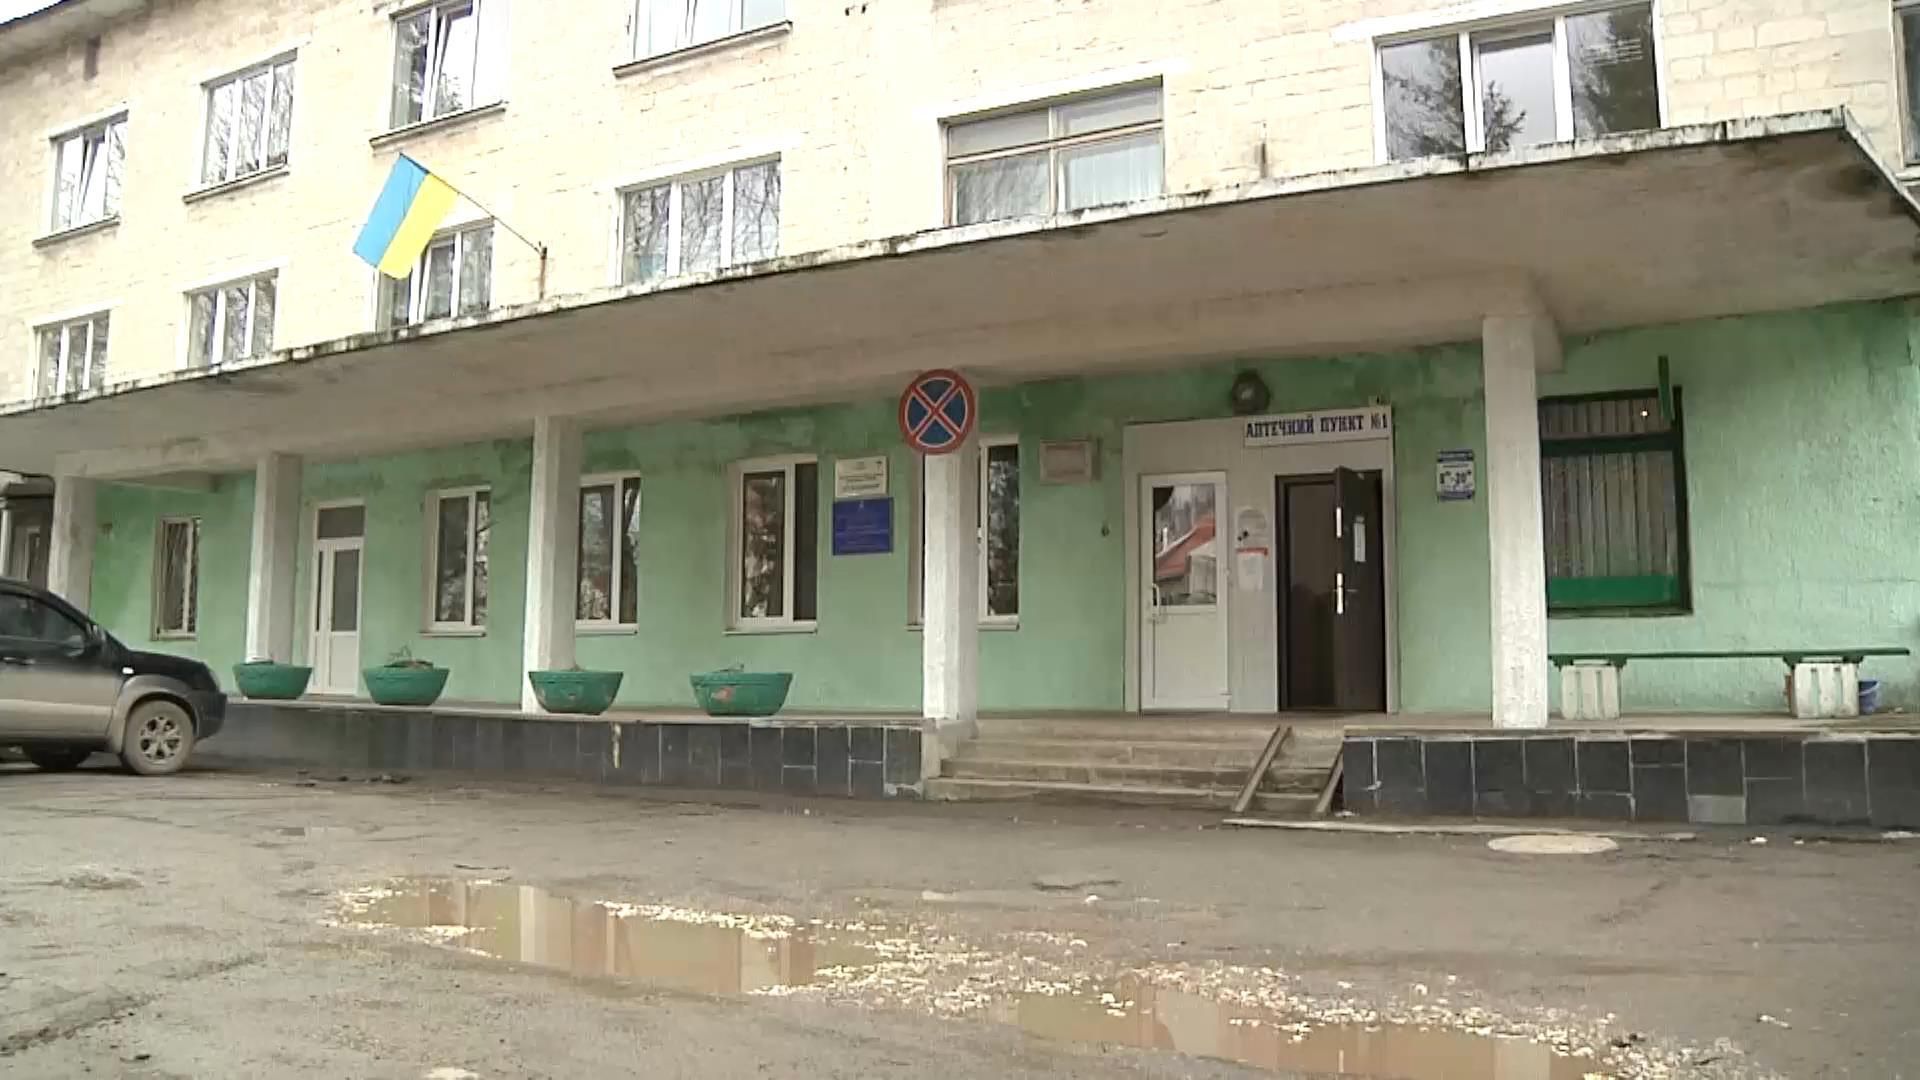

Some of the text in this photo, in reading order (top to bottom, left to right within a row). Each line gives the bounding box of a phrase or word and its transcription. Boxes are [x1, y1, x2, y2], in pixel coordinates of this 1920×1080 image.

[1246, 412, 1388, 438] АПТЕЧНИЙ ПУНКТ №1
